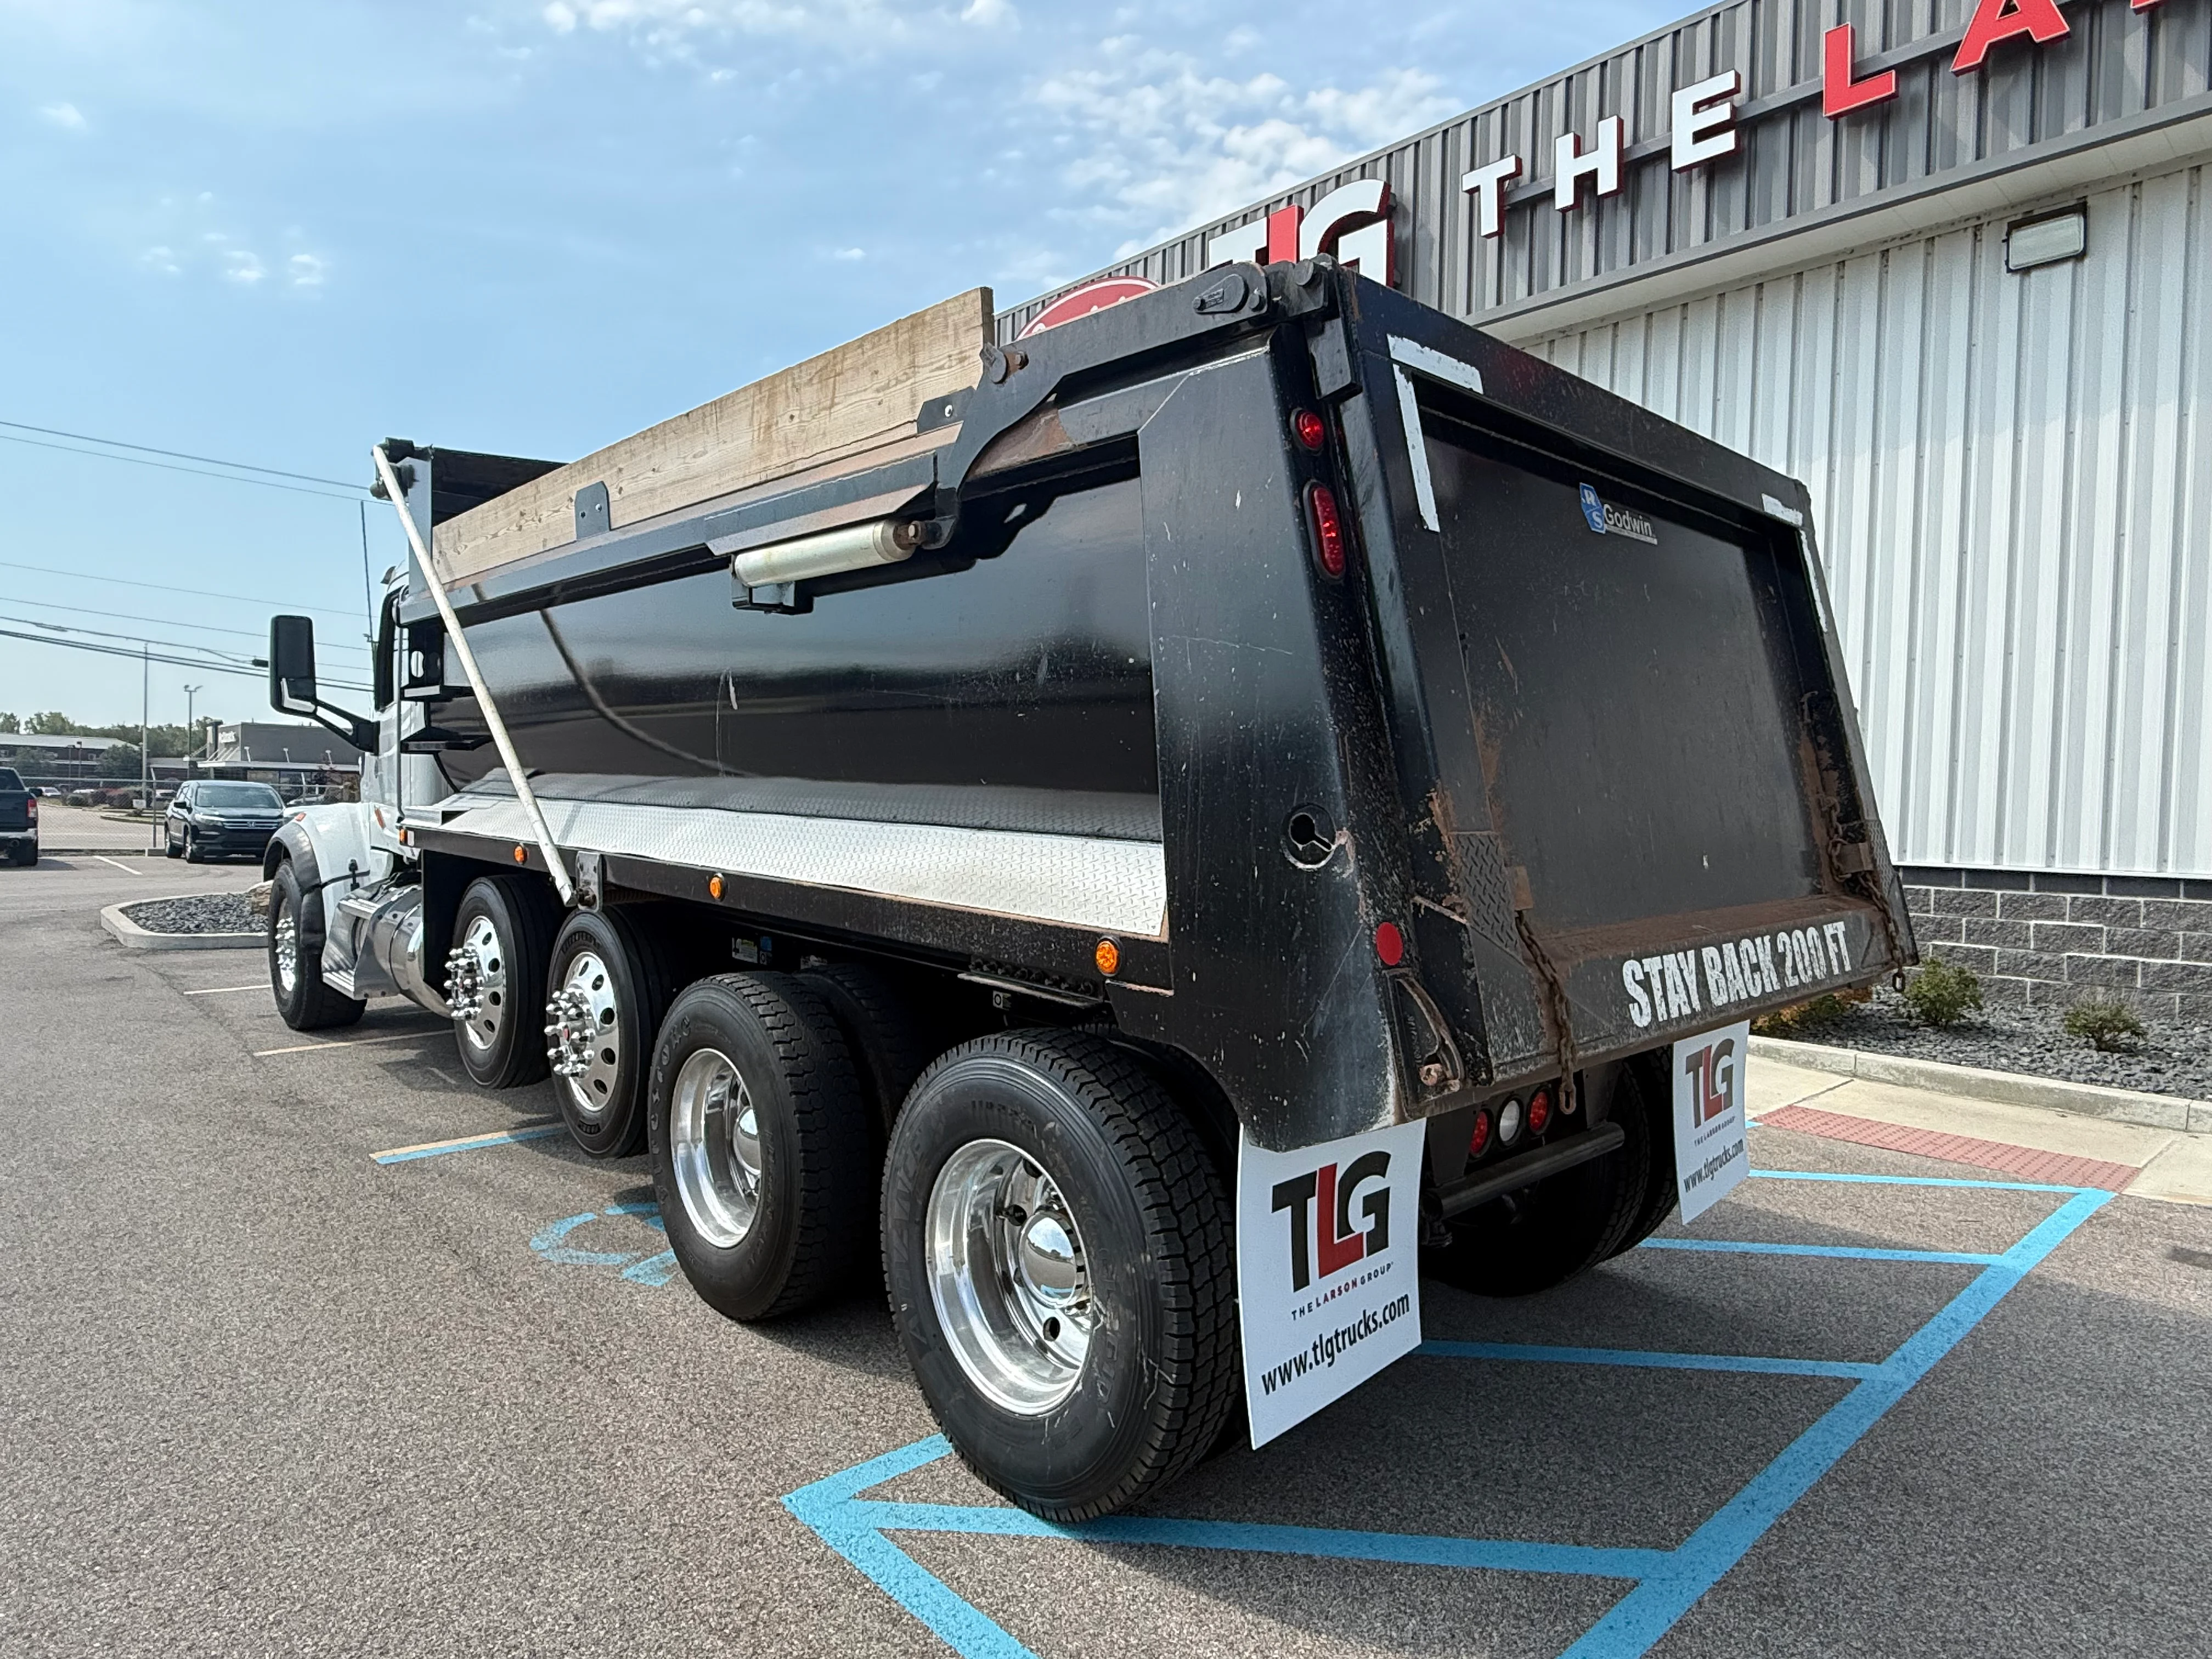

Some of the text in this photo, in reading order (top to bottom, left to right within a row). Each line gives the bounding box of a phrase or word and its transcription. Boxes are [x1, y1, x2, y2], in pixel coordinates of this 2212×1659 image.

[1462, 0, 2164, 238] THE LA
[1603, 504, 1652, 537] Godwin
[1622, 921, 1852, 1028] STAY BACK 200 FT
[1685, 1038, 1735, 1129] TLG
[1684, 1138, 1744, 1193] www.tlgtrucks.com
[1271, 1150, 1392, 1293] TLG
[1291, 1263, 1391, 1321] THE LARSON GROUP
[1261, 1293, 1410, 1395] www.tlgtrucks.com
